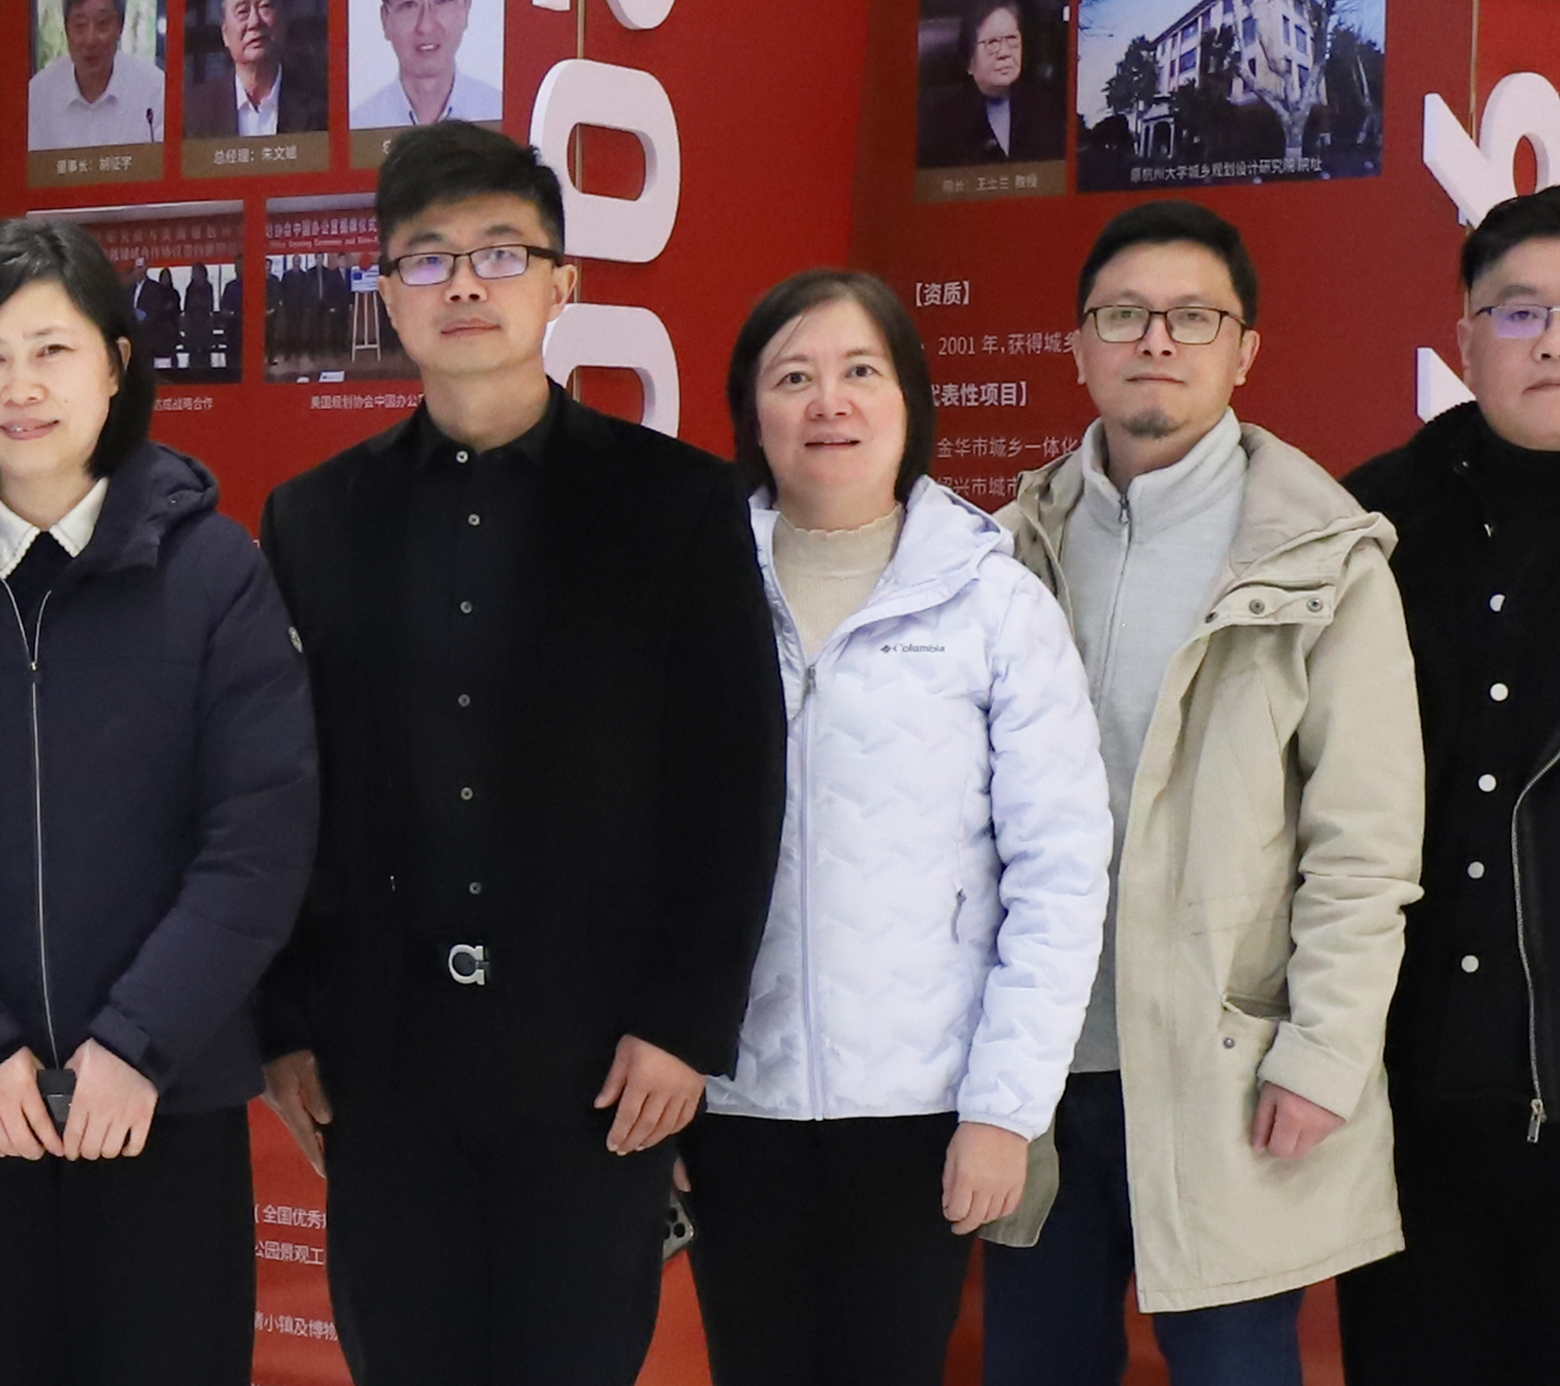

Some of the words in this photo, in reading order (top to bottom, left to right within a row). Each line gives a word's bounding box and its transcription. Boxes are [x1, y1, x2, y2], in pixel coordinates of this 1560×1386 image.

[914, 280, 971, 308] 【资质】
[937, 337, 976, 356] 2001
[936, 436, 1079, 459] 金华市城乡一体化
